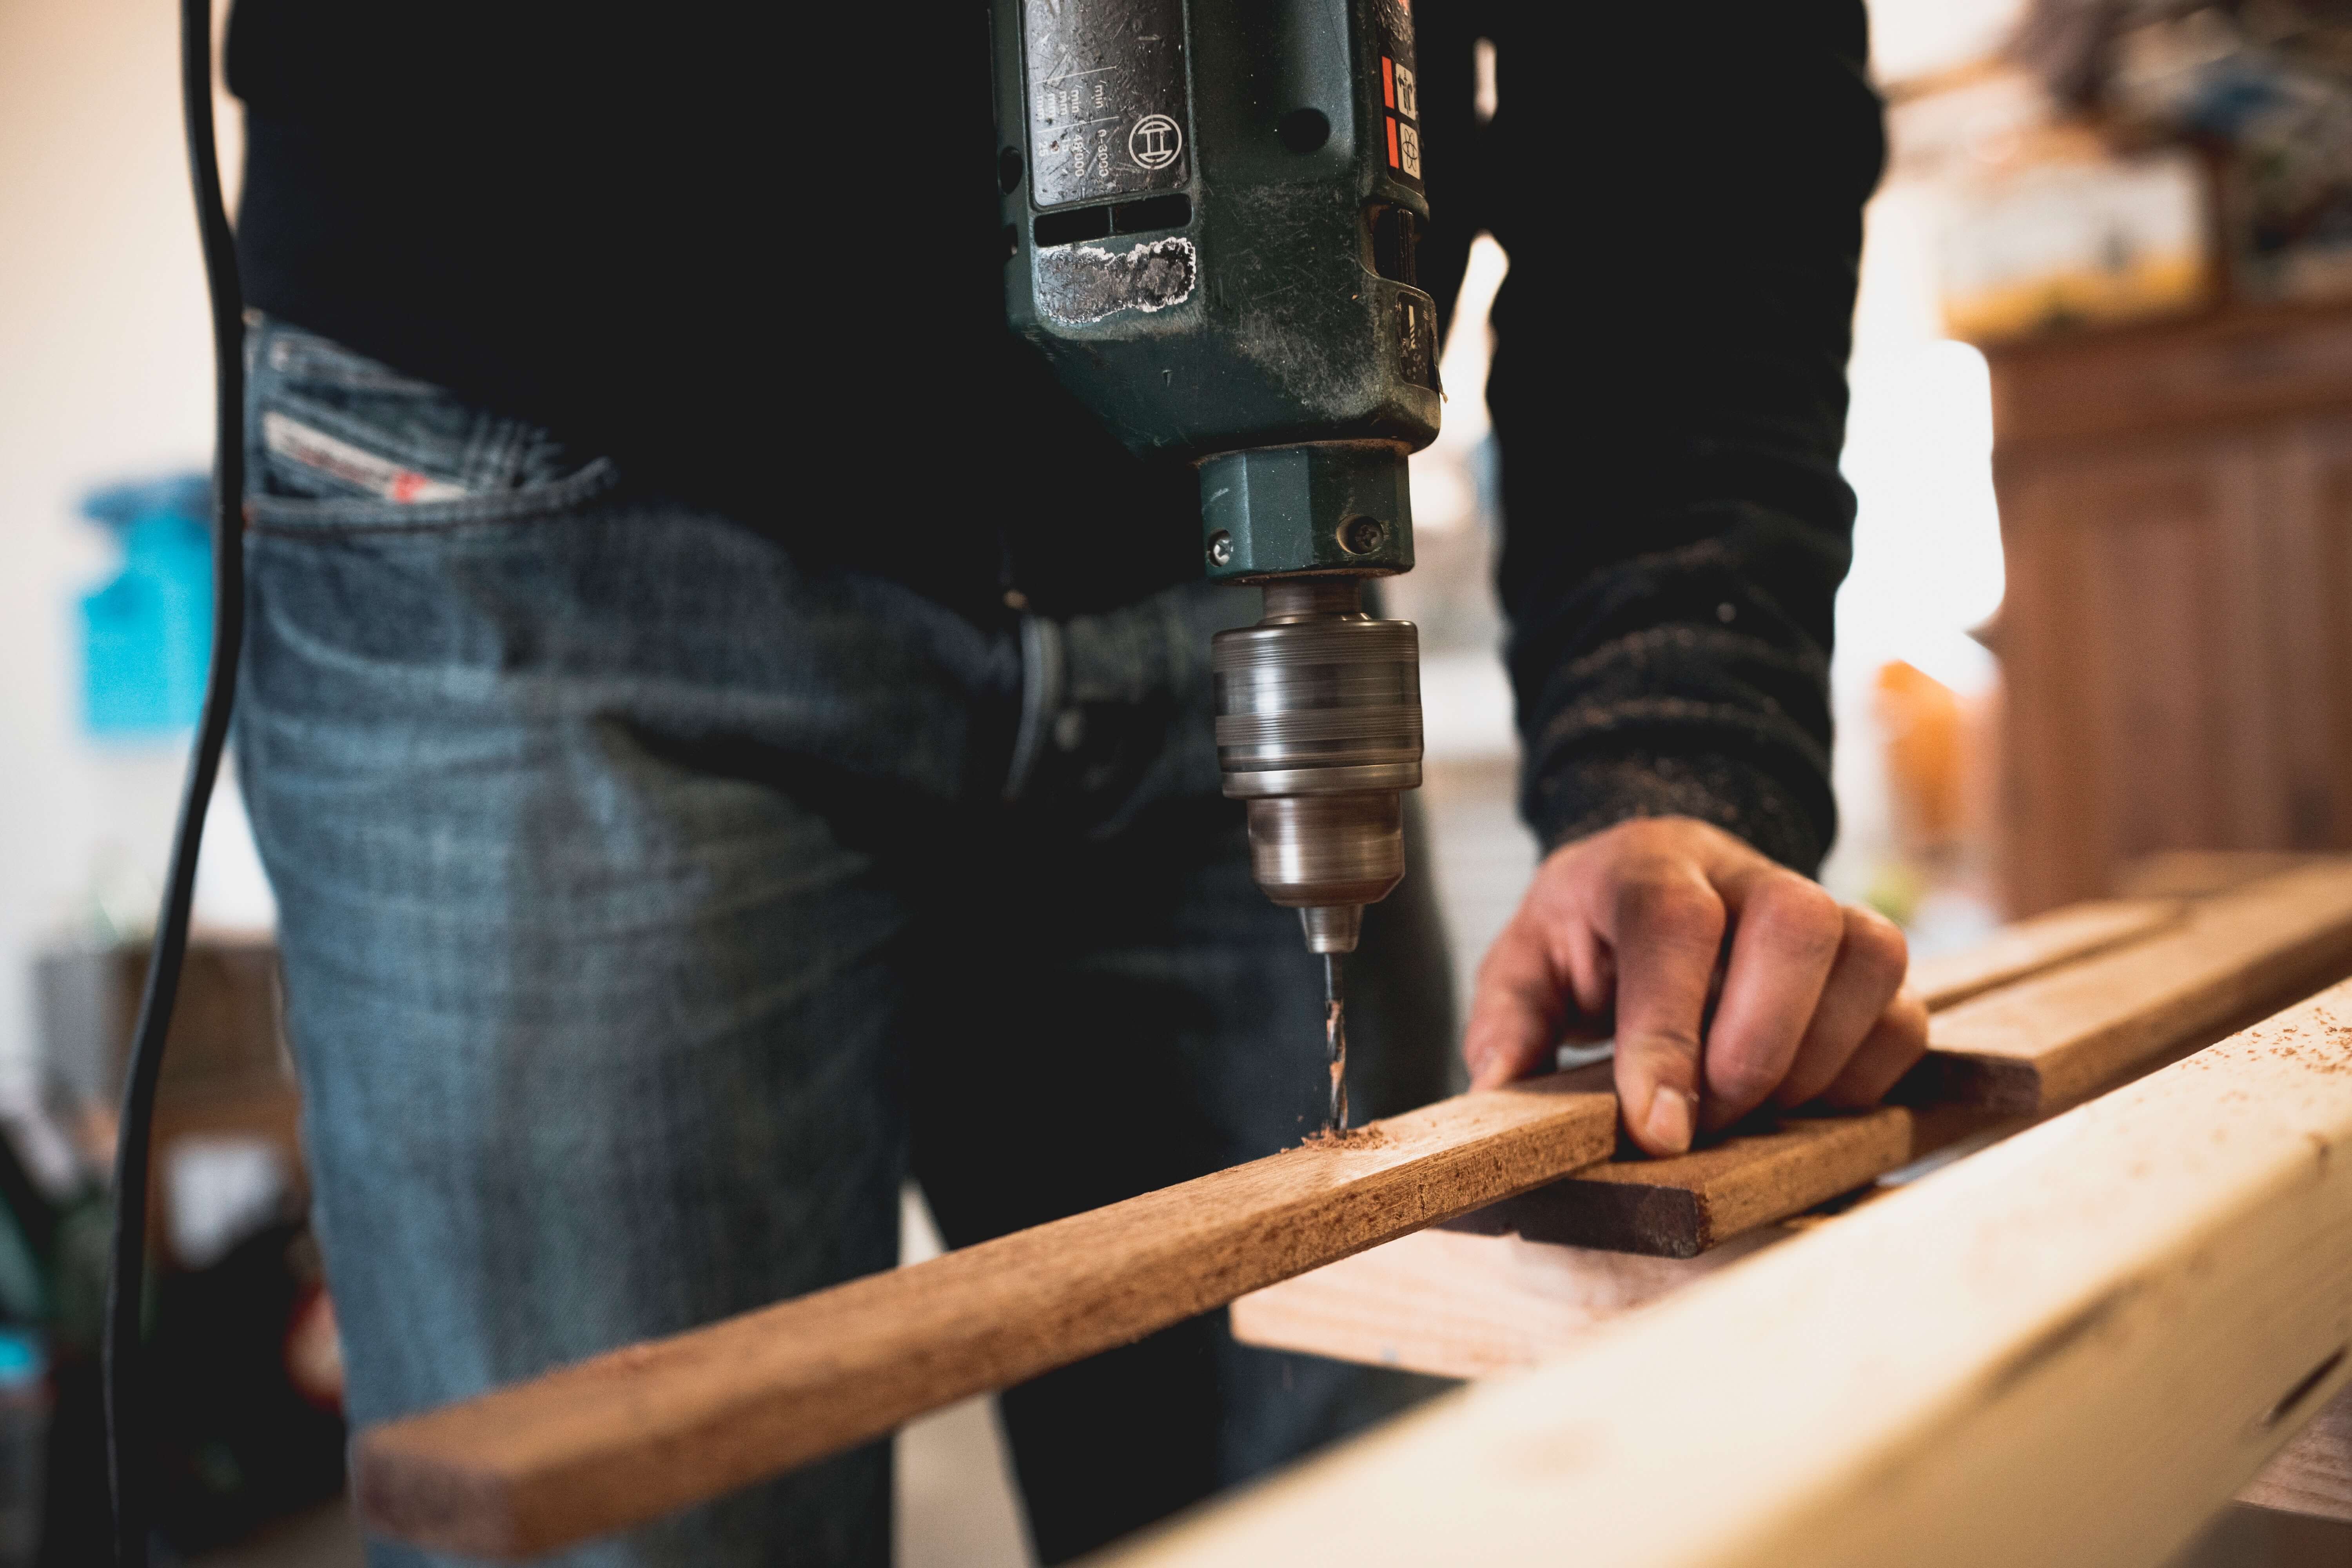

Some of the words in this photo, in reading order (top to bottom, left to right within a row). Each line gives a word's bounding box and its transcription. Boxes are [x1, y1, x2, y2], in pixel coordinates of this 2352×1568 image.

[1036, 95, 1044, 120] mm
[1059, 91, 1067, 116] mm
[1038, 141, 1048, 157] 25
[1062, 137, 1071, 152] 15
[1097, 129, 1109, 176] 0-3000
